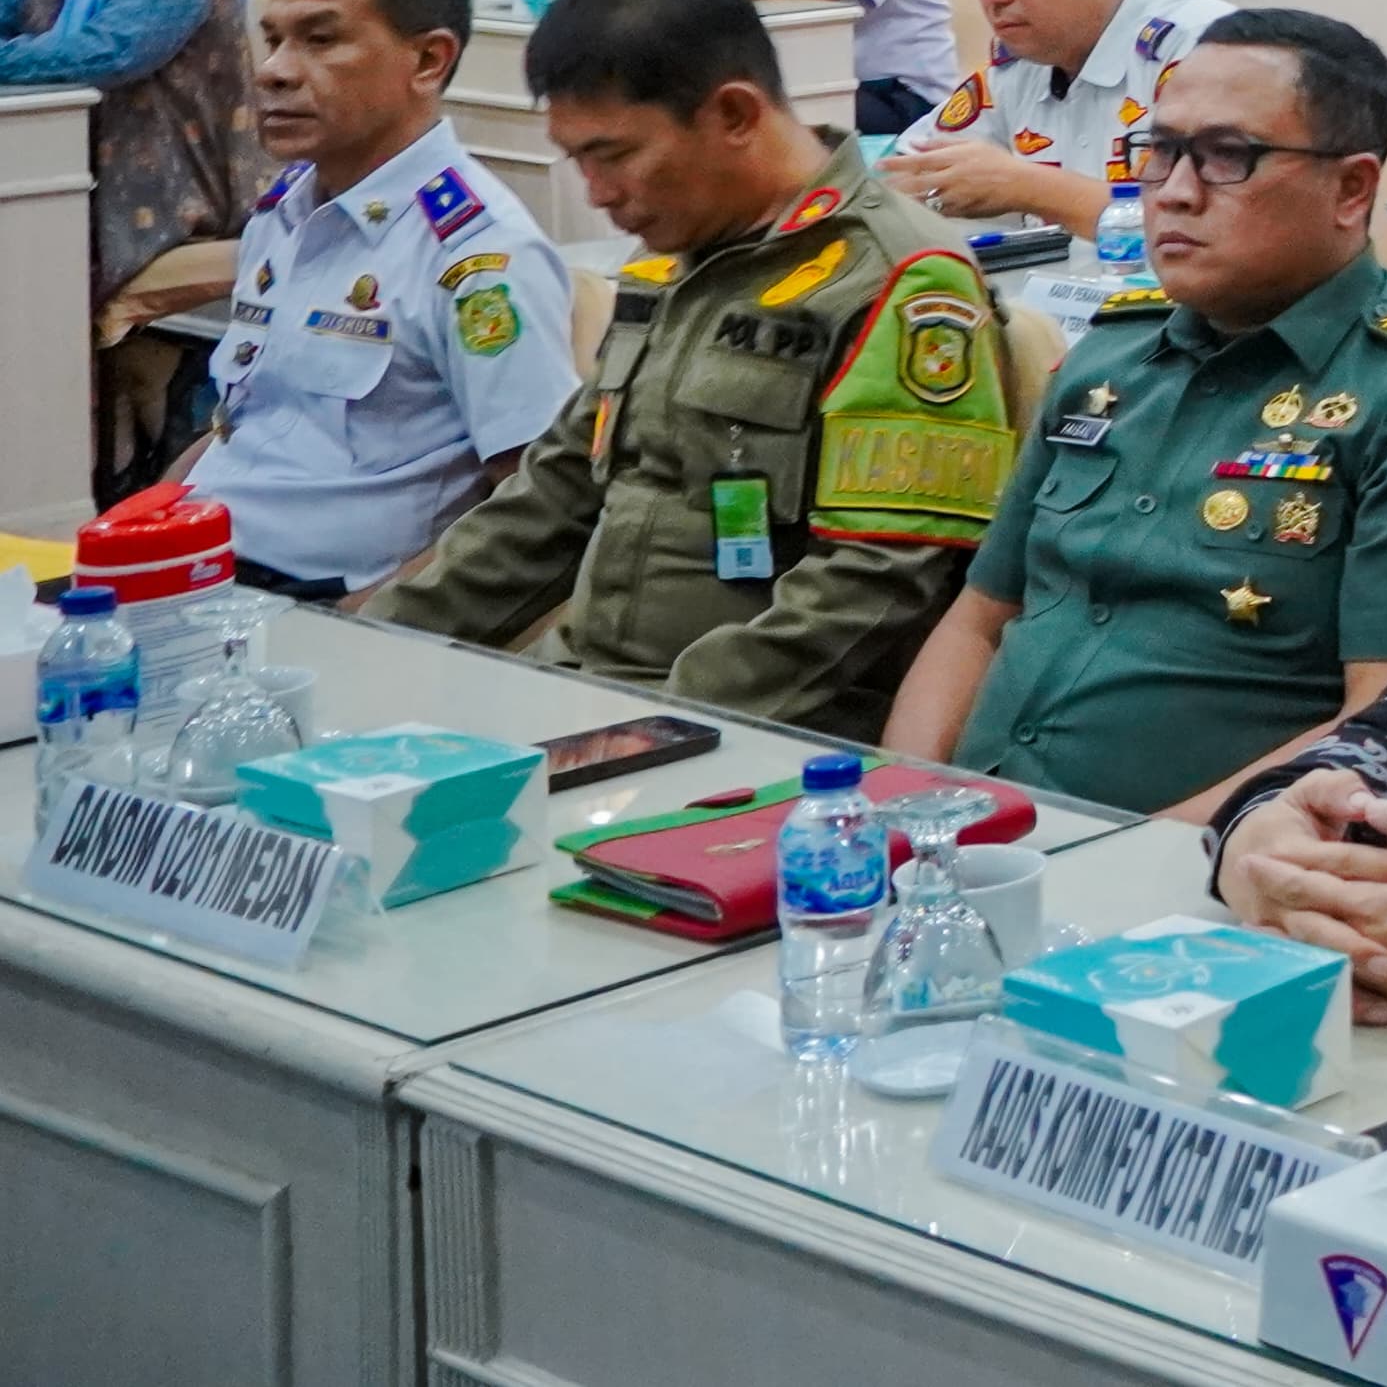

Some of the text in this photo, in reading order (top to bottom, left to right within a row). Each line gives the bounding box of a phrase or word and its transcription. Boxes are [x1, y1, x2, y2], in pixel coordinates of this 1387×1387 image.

[50, 784, 174, 887] DANDIM
[959, 1059, 1057, 1179] KADIS
[1028, 1081, 1162, 1216] KOMINFO
[1136, 1117, 1228, 1242] KOTA
